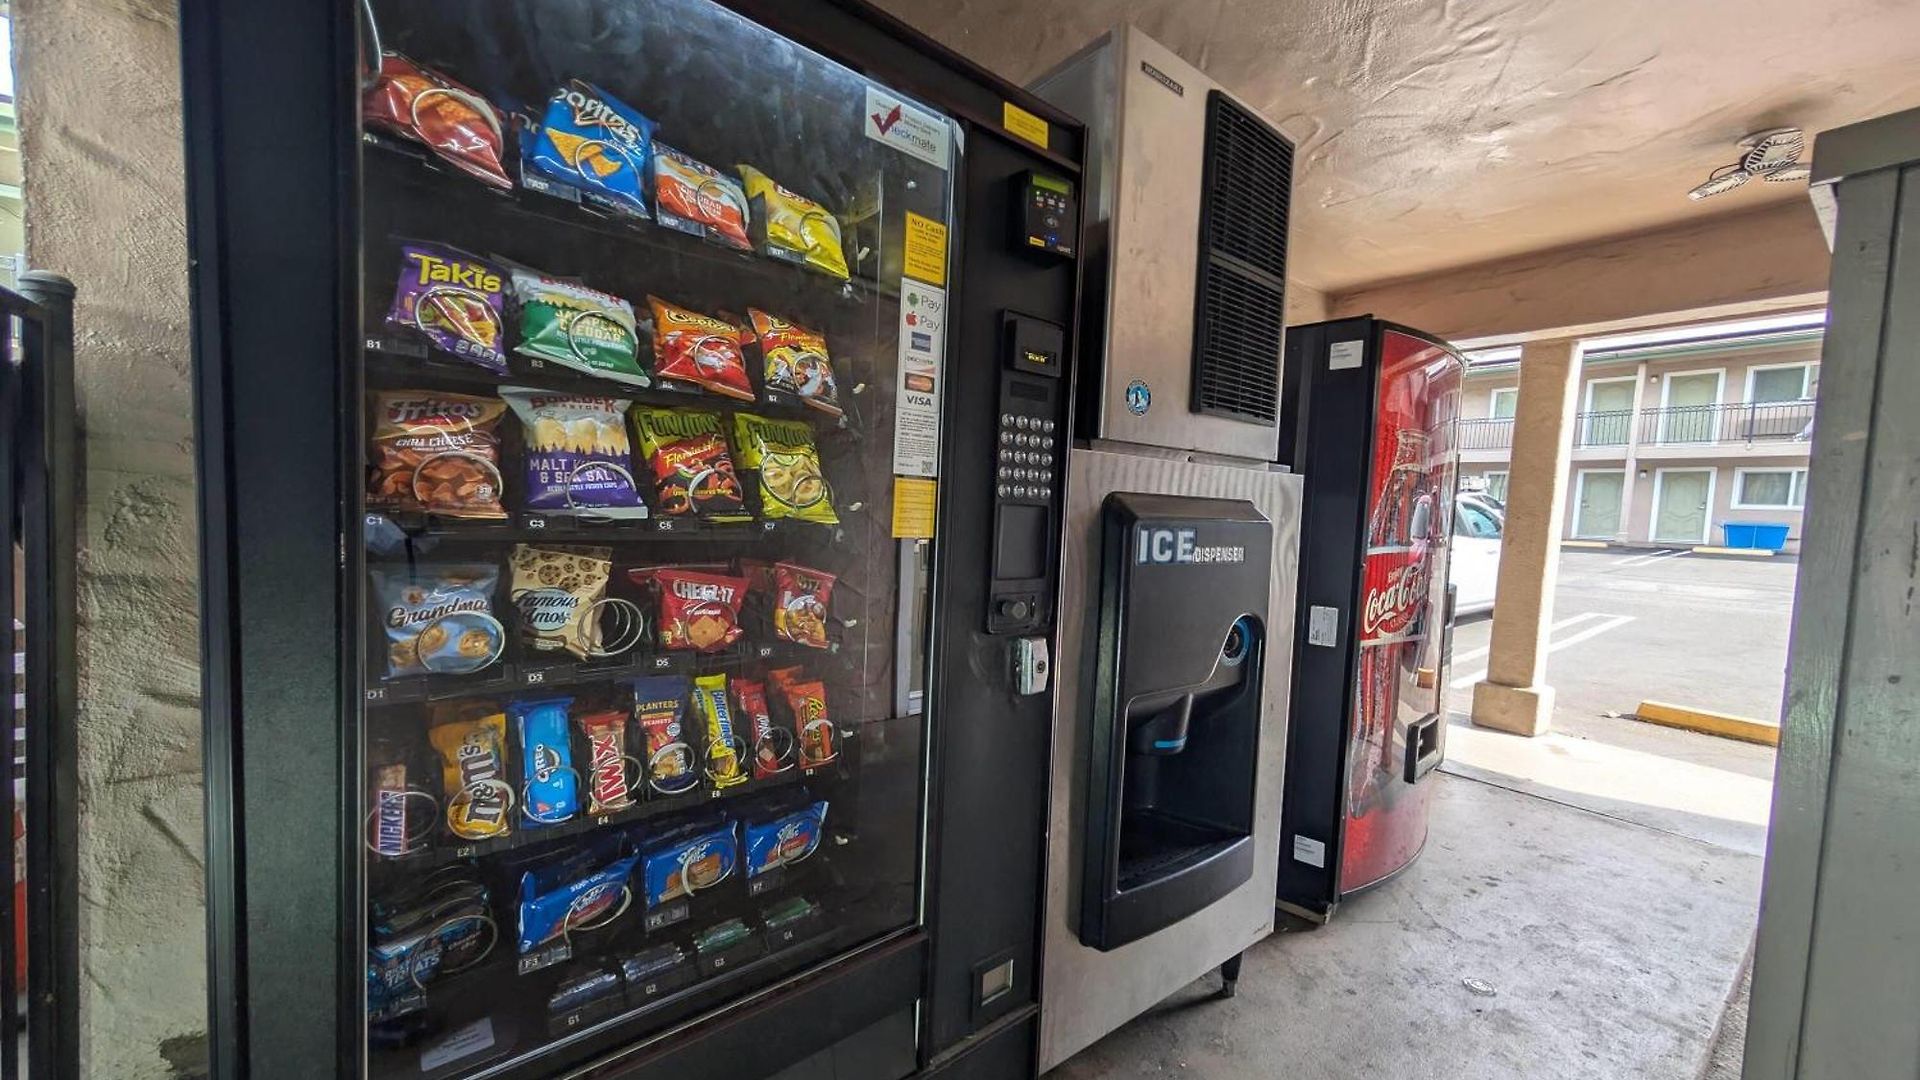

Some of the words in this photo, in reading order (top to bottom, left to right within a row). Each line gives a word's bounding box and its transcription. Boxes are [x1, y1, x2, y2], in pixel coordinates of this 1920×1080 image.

[409, 252, 502, 293] Takis
[921, 294, 941, 313] Pay
[920, 315, 940, 333] Pay
[366, 339, 381, 349] B1
[907, 394, 932, 407] VISA
[529, 458, 568, 471] MALT
[540, 471, 549, 484] &
[366, 515, 383, 526] C1
[529, 519, 545, 528] C3
[1138, 528, 1195, 562] ICE
[1193, 546, 1245, 564] DISPENSER
[367, 689, 384, 700] D1
[635, 700, 680, 713] PLANTERS
[535, 743, 550, 783] OREO
[590, 734, 629, 804] TWIX
